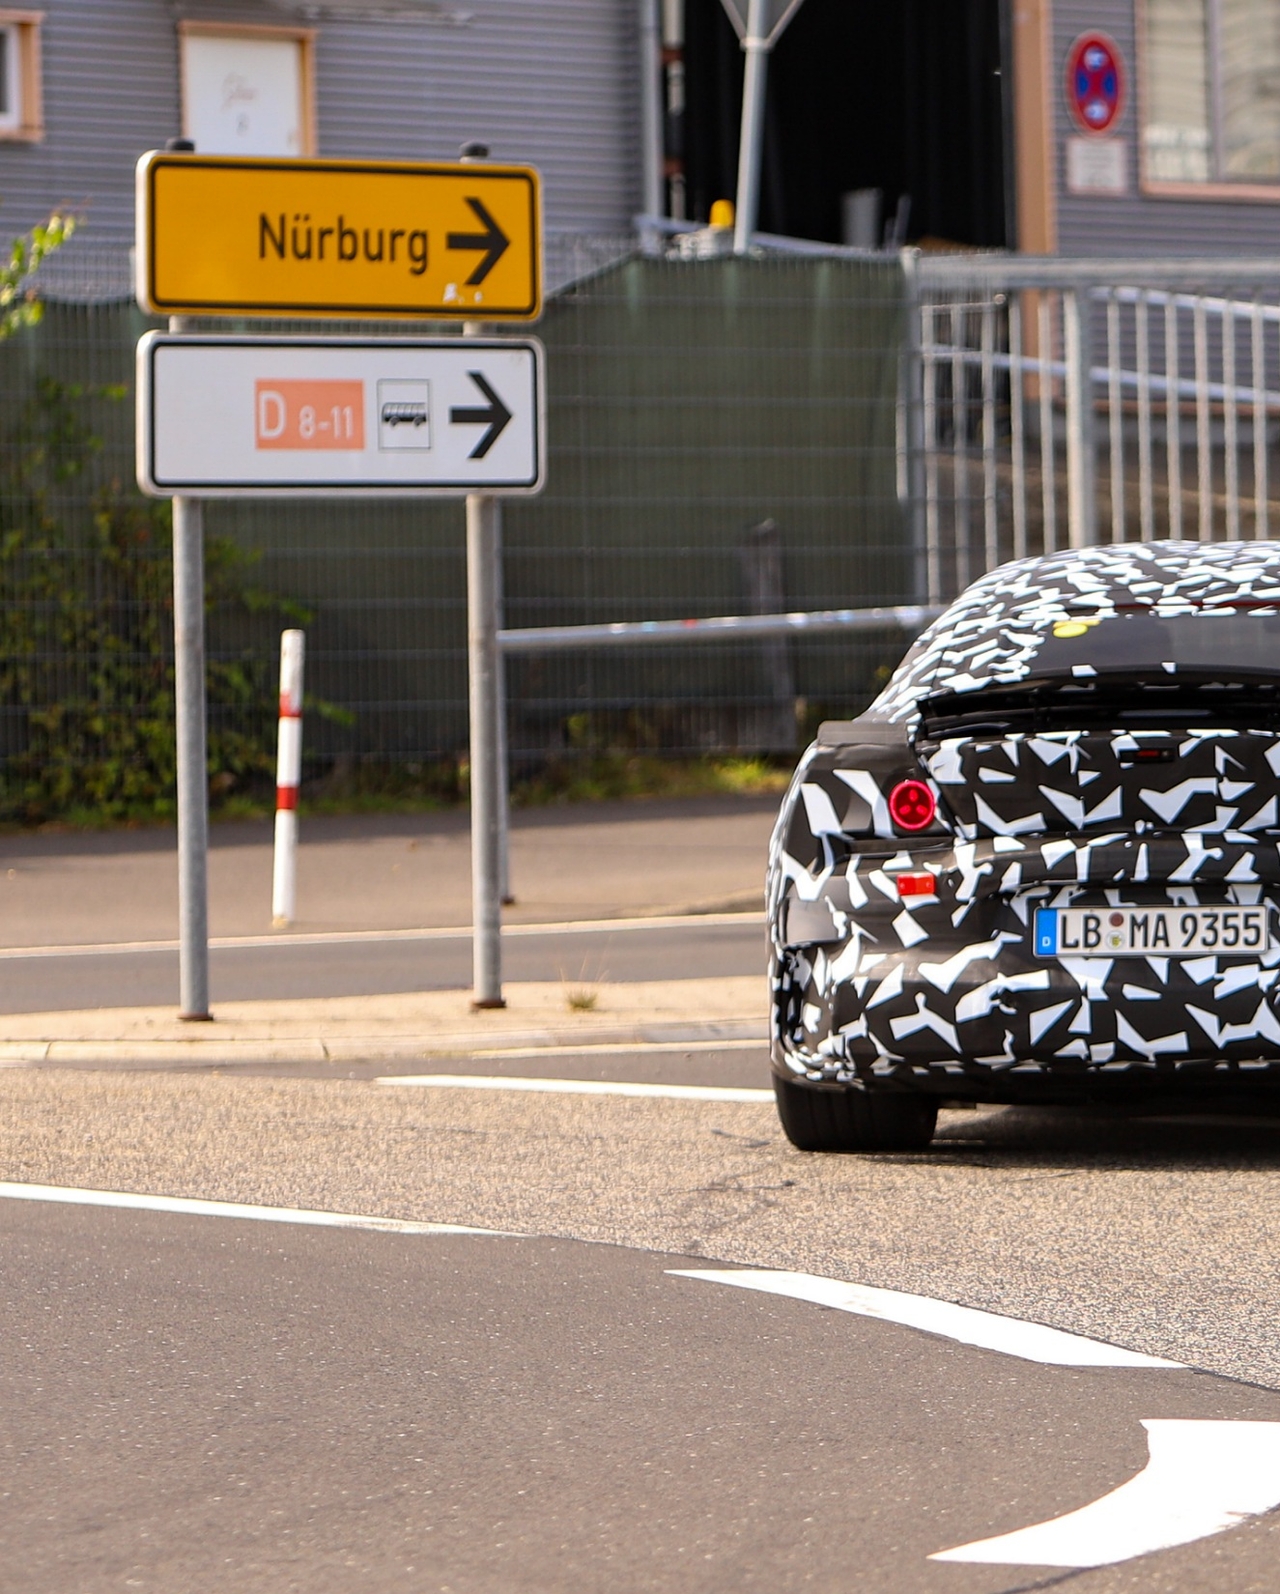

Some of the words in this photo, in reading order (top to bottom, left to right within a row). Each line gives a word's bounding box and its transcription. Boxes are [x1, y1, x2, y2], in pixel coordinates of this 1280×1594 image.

[258, 212, 428, 277] Nürburg
[258, 390, 287, 441] D
[299, 405, 354, 440] 8-11
[1041, 935, 1051, 947] D
[1061, 914, 1101, 949] LB
[1130, 913, 1170, 948] MA
[1180, 912, 1261, 948] 9355
